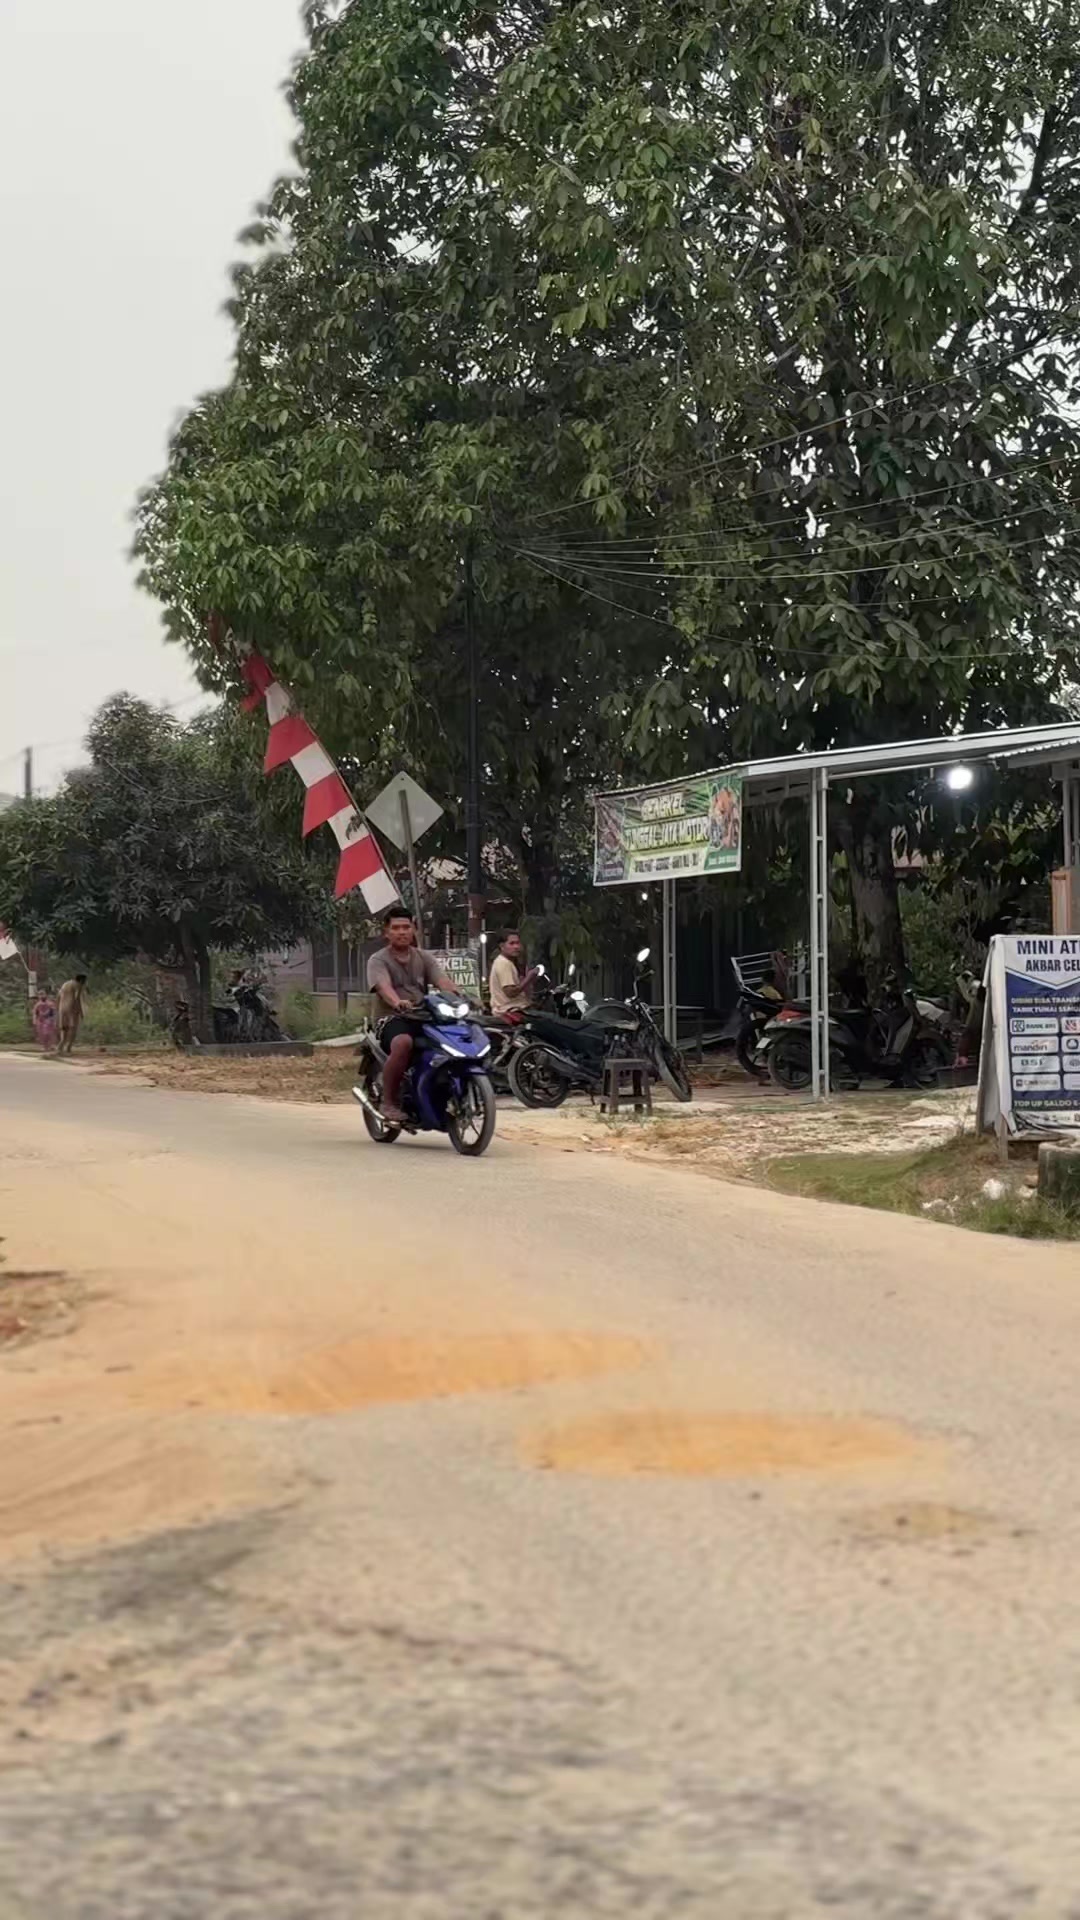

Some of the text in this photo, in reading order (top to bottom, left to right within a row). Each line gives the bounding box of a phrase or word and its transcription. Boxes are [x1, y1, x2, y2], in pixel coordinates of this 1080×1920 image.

[1017, 940, 1080, 954] MINI AT
[1026, 959, 1061, 972] AKBAR
